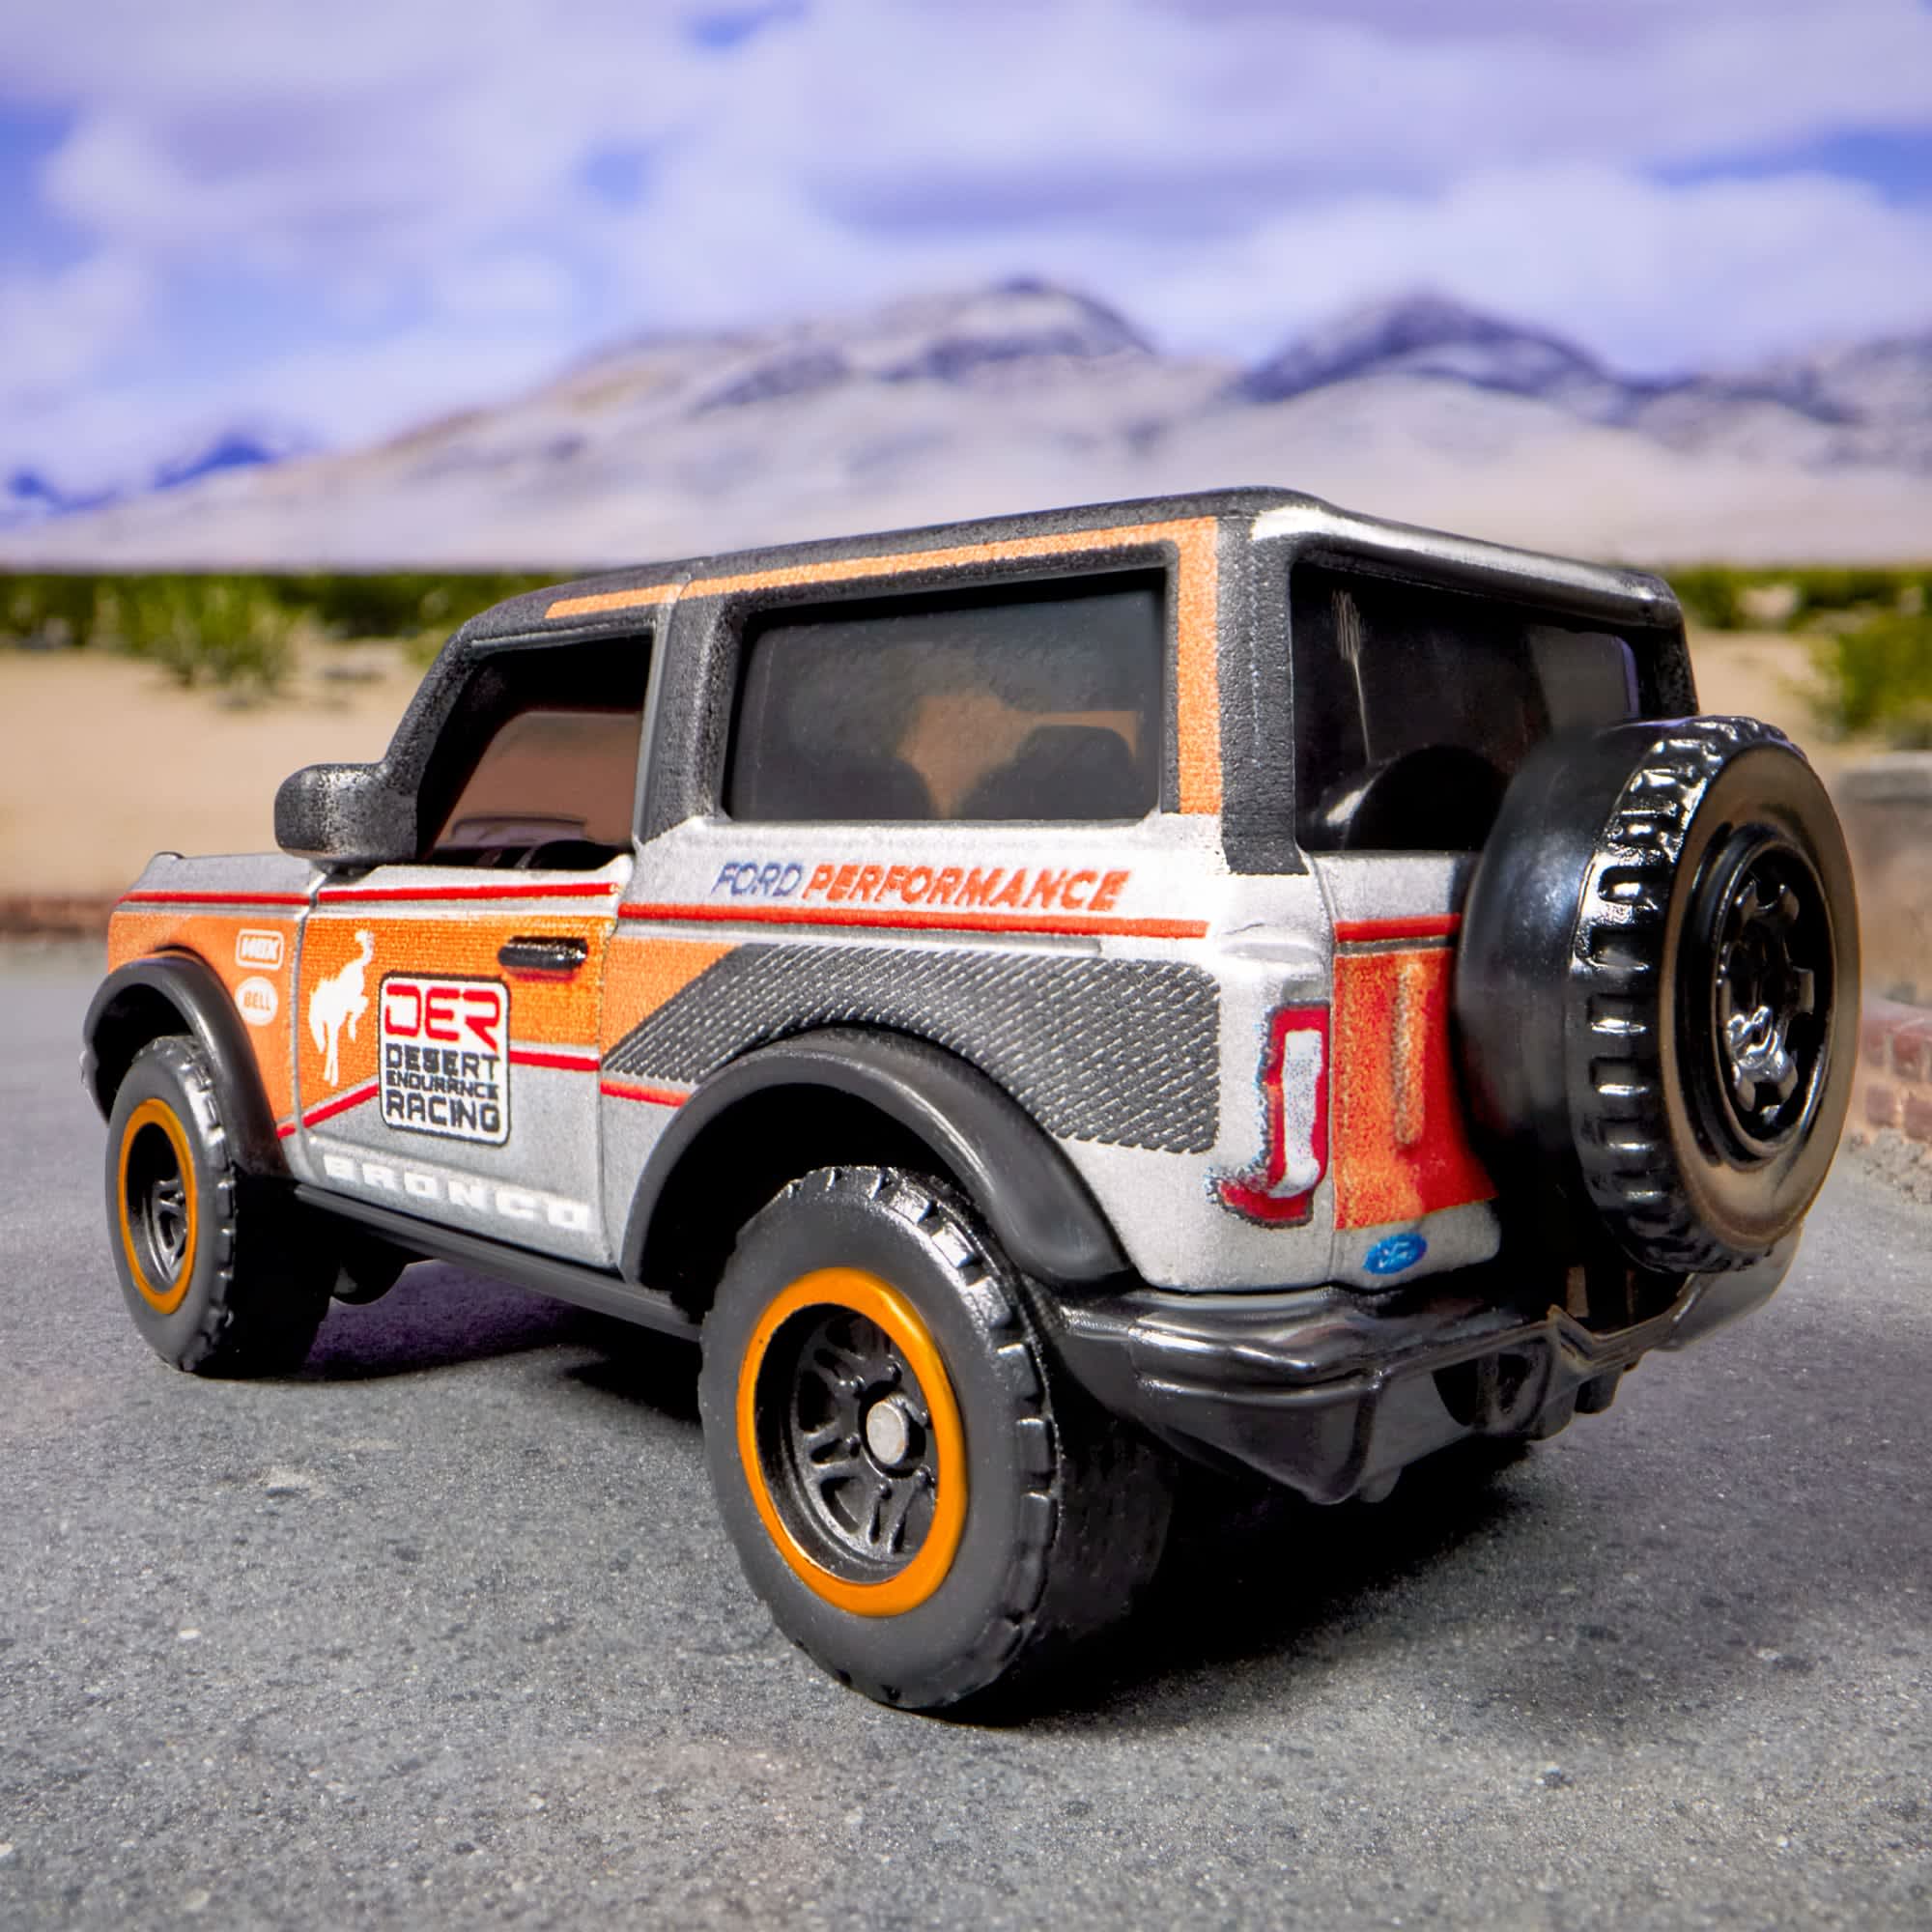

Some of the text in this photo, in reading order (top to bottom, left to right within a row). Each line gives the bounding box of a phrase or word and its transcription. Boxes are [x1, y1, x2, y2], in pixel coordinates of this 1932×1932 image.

[712, 863, 1130, 911] FORD PERFORMANCE
[384, 983, 500, 1052] DER
[385, 1042, 500, 1080] DESERT
[385, 1069, 499, 1100] ENDURANCE
[385, 1089, 500, 1133] RACING
[323, 1153, 591, 1231] BRONCO
